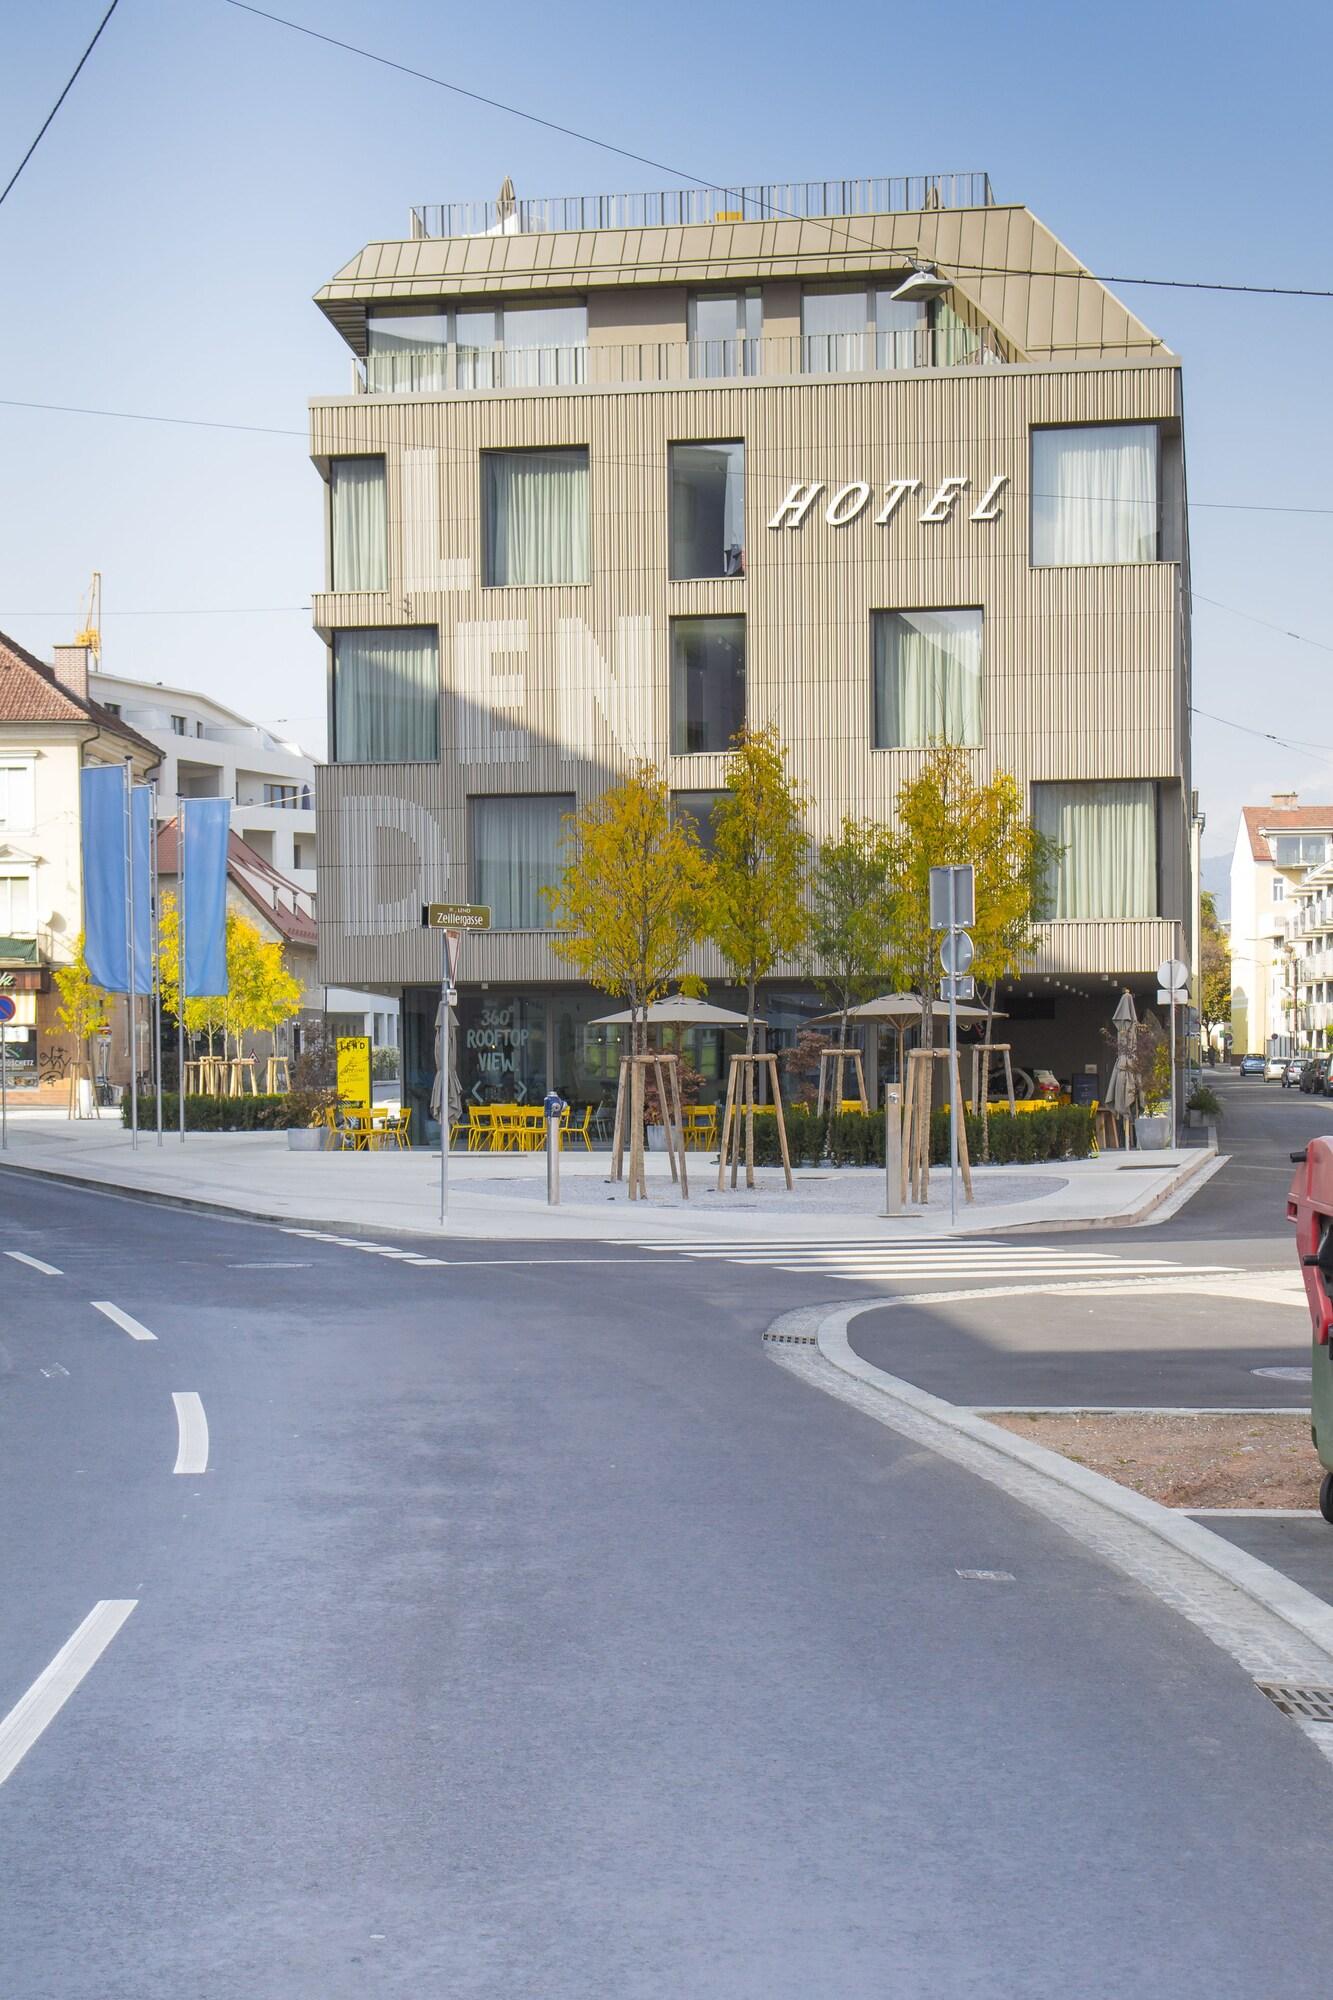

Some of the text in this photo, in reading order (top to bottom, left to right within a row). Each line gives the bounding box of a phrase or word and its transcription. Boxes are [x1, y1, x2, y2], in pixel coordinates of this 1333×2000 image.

[767, 475, 1008, 528] HOTEL
[436, 912, 483, 926] Zeillergasse
[467, 1028, 529, 1049] ROOFTOP
